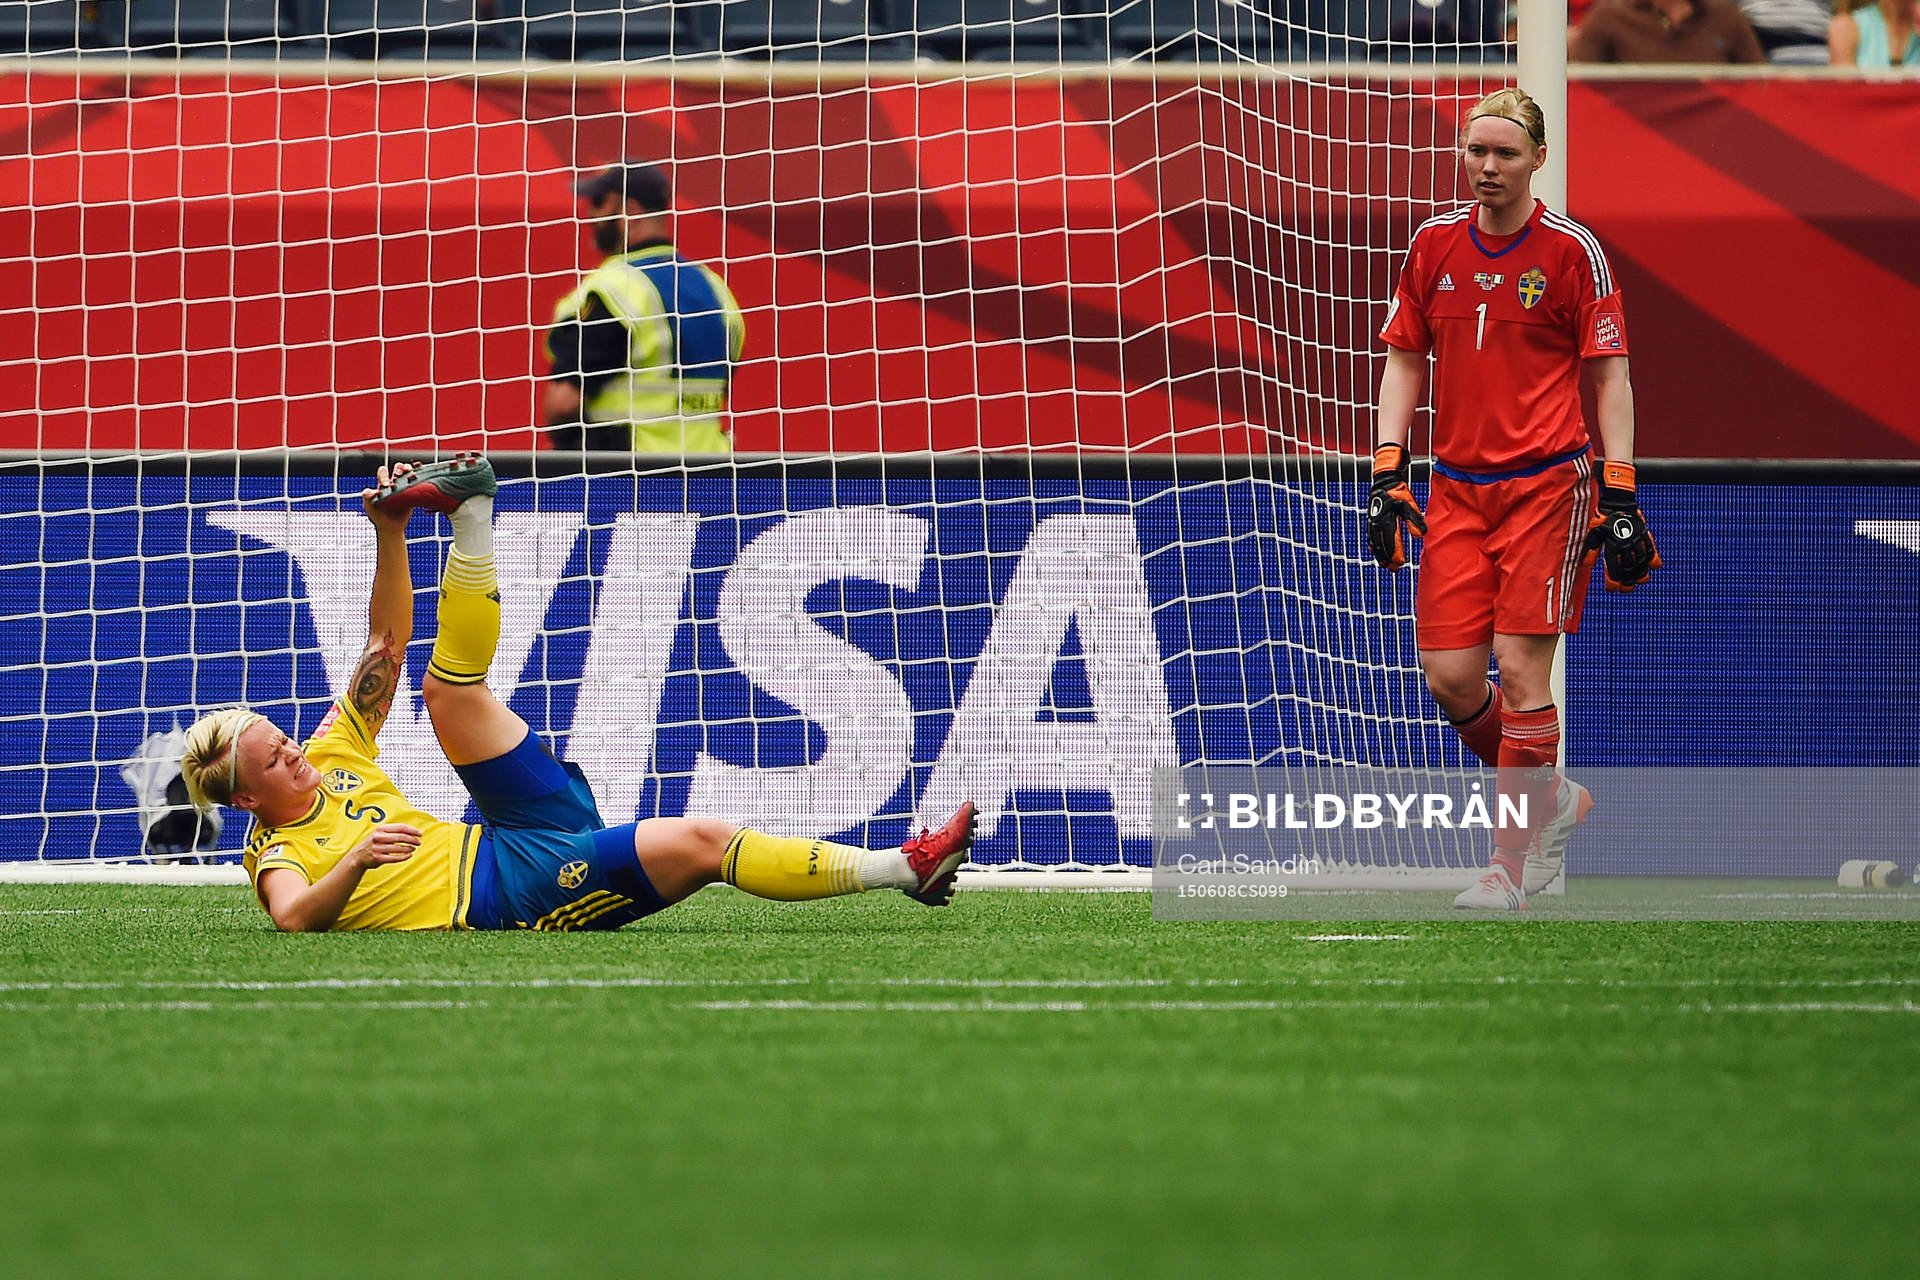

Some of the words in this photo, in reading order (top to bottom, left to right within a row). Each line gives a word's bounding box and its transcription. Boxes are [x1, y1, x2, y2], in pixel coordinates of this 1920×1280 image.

[1475, 303, 1487, 350] 1
[1597, 317, 1611, 328] LIVE
[1597, 323, 1617, 337] YOUR
[1598, 330, 1619, 346] GOALS
[1546, 576, 1555, 624] 1
[206, 504, 1196, 840] VISA
[345, 799, 386, 823] 5
